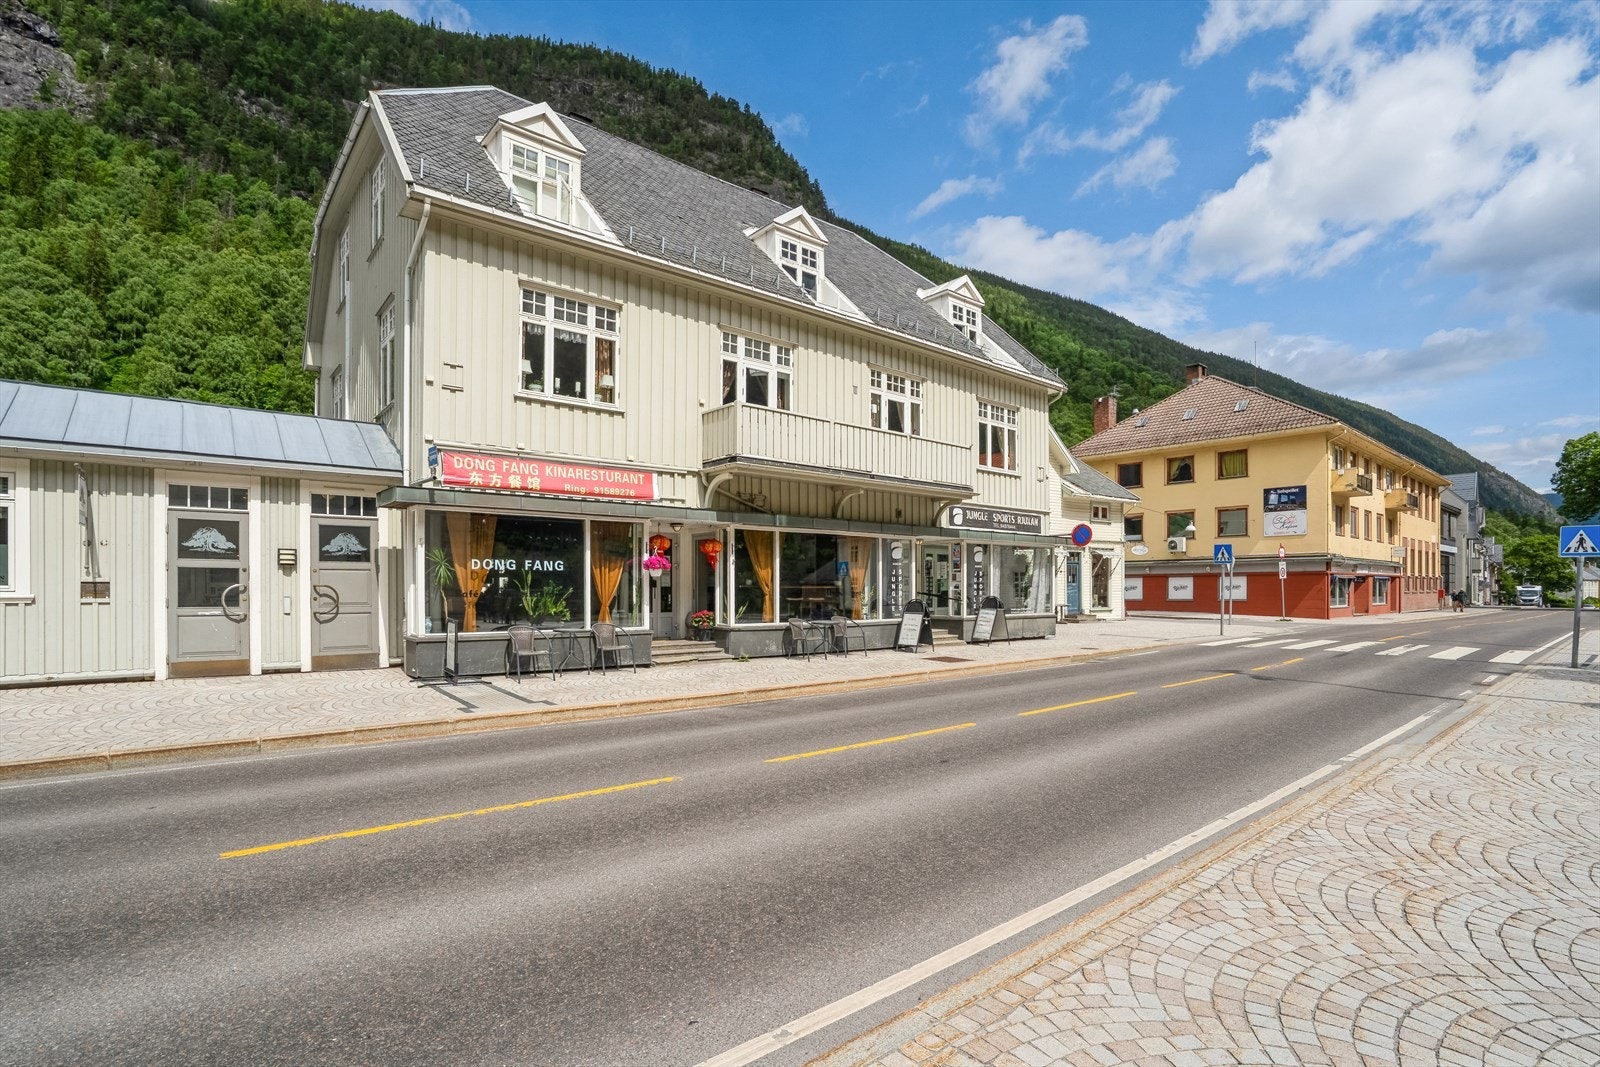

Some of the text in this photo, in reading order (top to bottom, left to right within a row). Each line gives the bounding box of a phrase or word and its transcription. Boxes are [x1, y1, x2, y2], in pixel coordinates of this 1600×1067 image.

[453, 456, 645, 485] DONG FANG KINARESTURANT
[469, 472, 541, 491] 东方餐馆
[564, 484, 635, 497] Ring: 91589276
[966, 510, 988, 521] JUNGLE
[993, 513, 1015, 524] SPORTS
[471, 559, 564, 571] DONG FANG
